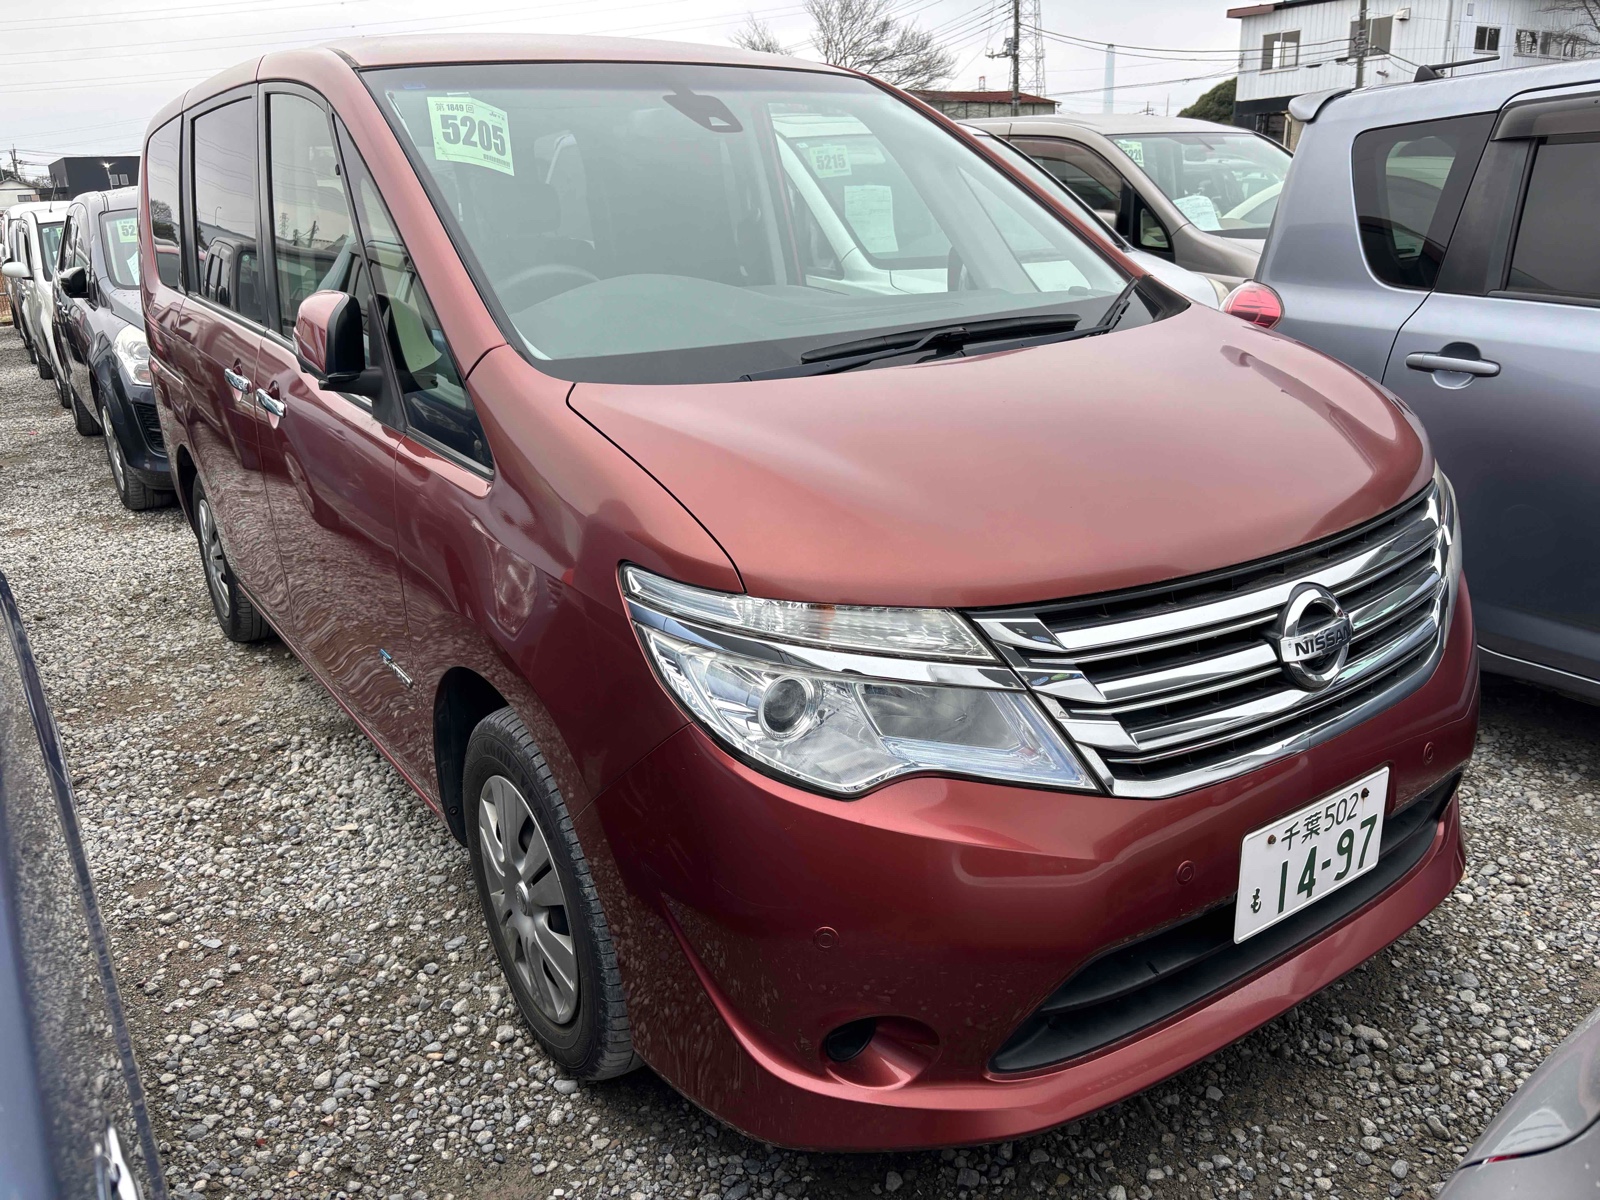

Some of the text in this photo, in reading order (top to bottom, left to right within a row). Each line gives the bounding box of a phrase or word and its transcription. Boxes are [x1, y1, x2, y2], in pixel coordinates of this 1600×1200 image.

[440, 115, 507, 156] 5205
[816, 154, 846, 170] 5215
[121, 224, 137, 237] 52
[1295, 625, 1351, 657] NISSAN
[1250, 814, 1378, 914] も 14-97
